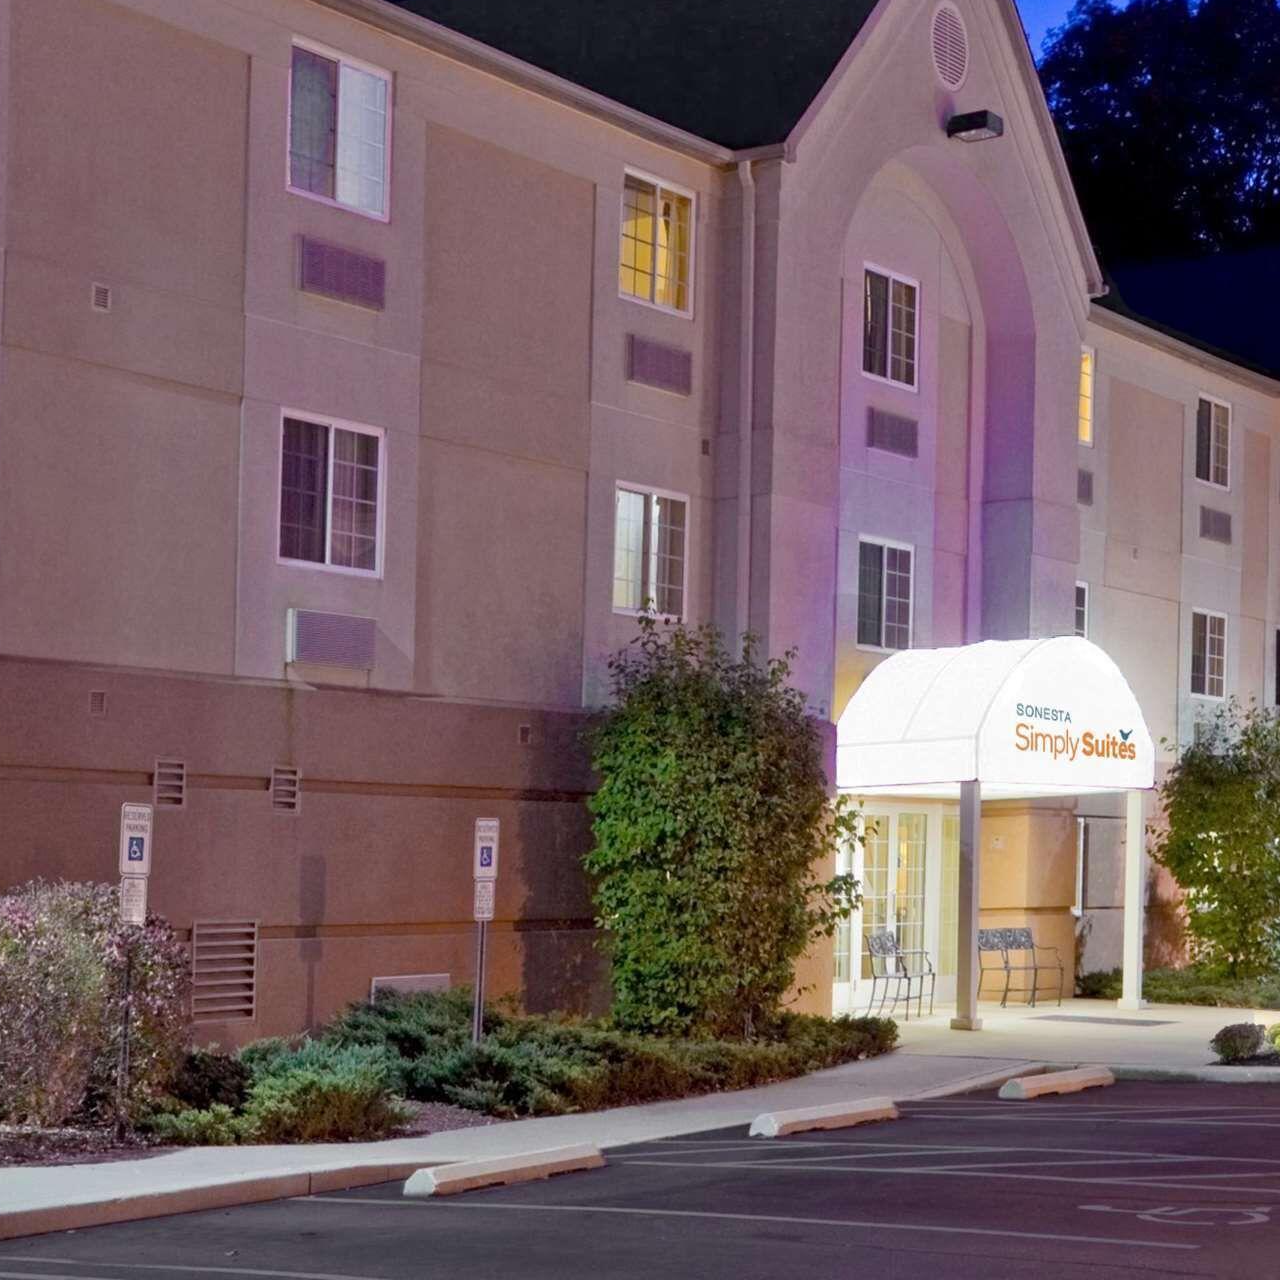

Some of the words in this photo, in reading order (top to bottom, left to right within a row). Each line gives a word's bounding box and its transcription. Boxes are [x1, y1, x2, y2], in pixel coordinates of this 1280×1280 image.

[1016, 703, 1072, 723] SONESTA
[1015, 723, 1079, 761] Simply
[1082, 732, 1136, 760] Suites
